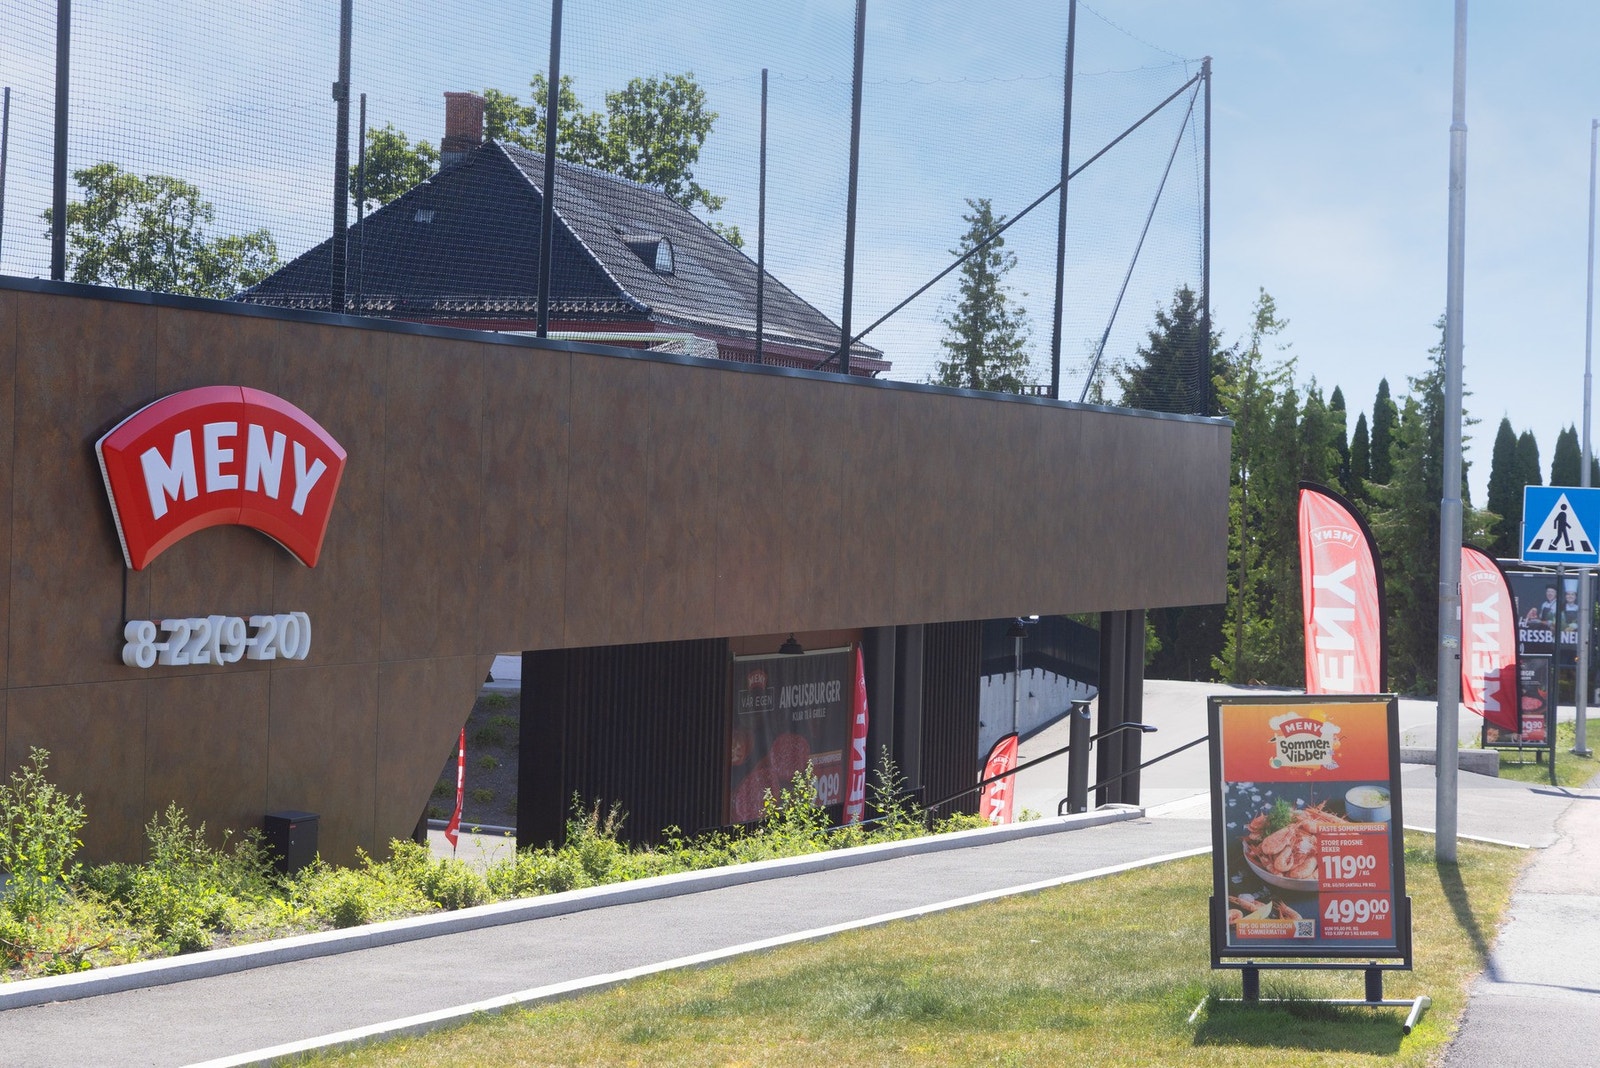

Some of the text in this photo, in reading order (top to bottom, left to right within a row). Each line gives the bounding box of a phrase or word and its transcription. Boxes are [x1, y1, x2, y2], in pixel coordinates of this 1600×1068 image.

[140, 421, 327, 521] MENY
[779, 679, 841, 709] ANGUSBURGER
[1285, 721, 1321, 733] MENY
[1337, 824, 1385, 832] SOMMERPRISER
